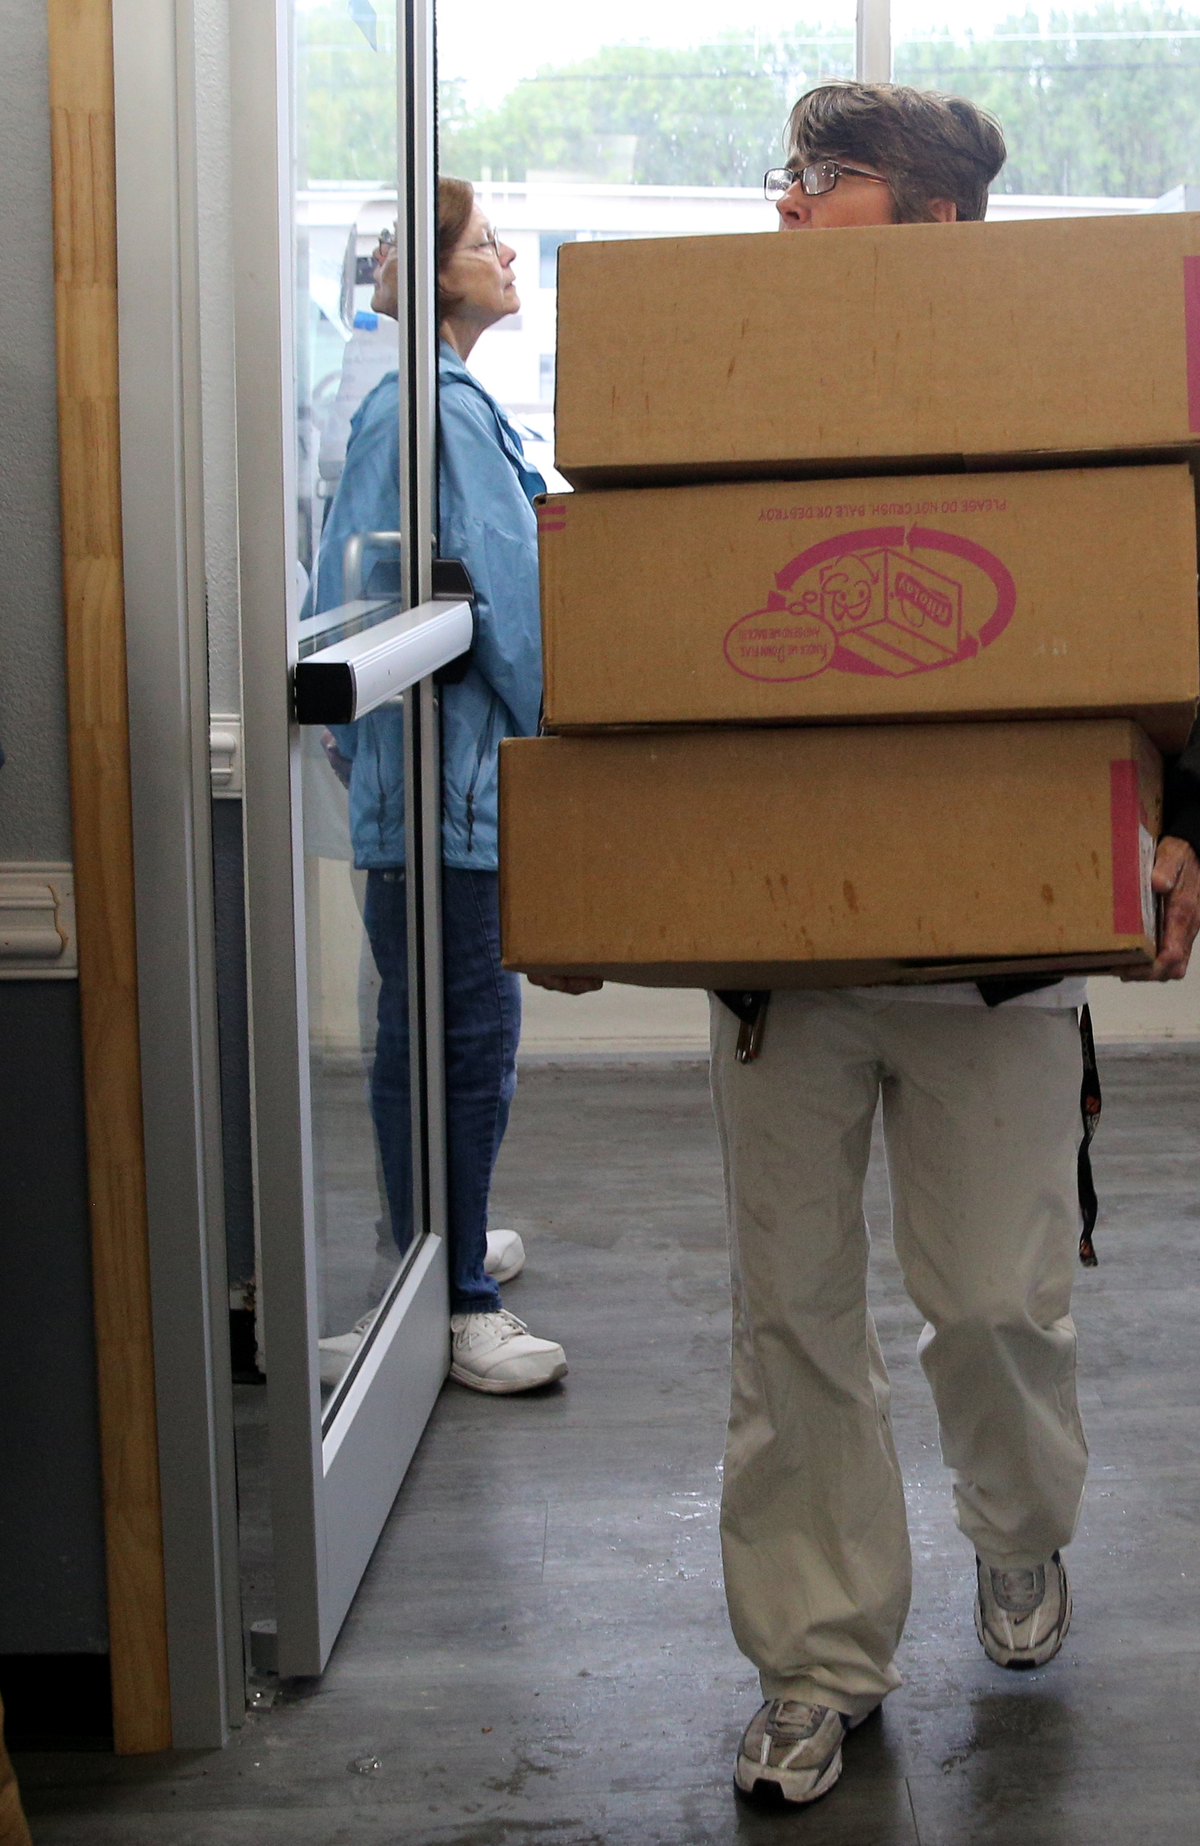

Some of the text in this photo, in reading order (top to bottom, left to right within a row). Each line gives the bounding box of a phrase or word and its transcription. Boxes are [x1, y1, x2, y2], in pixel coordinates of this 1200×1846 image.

[758, 499, 1007, 521] PLEASE DO NOT CRUSH, BALE OR DESTROY
